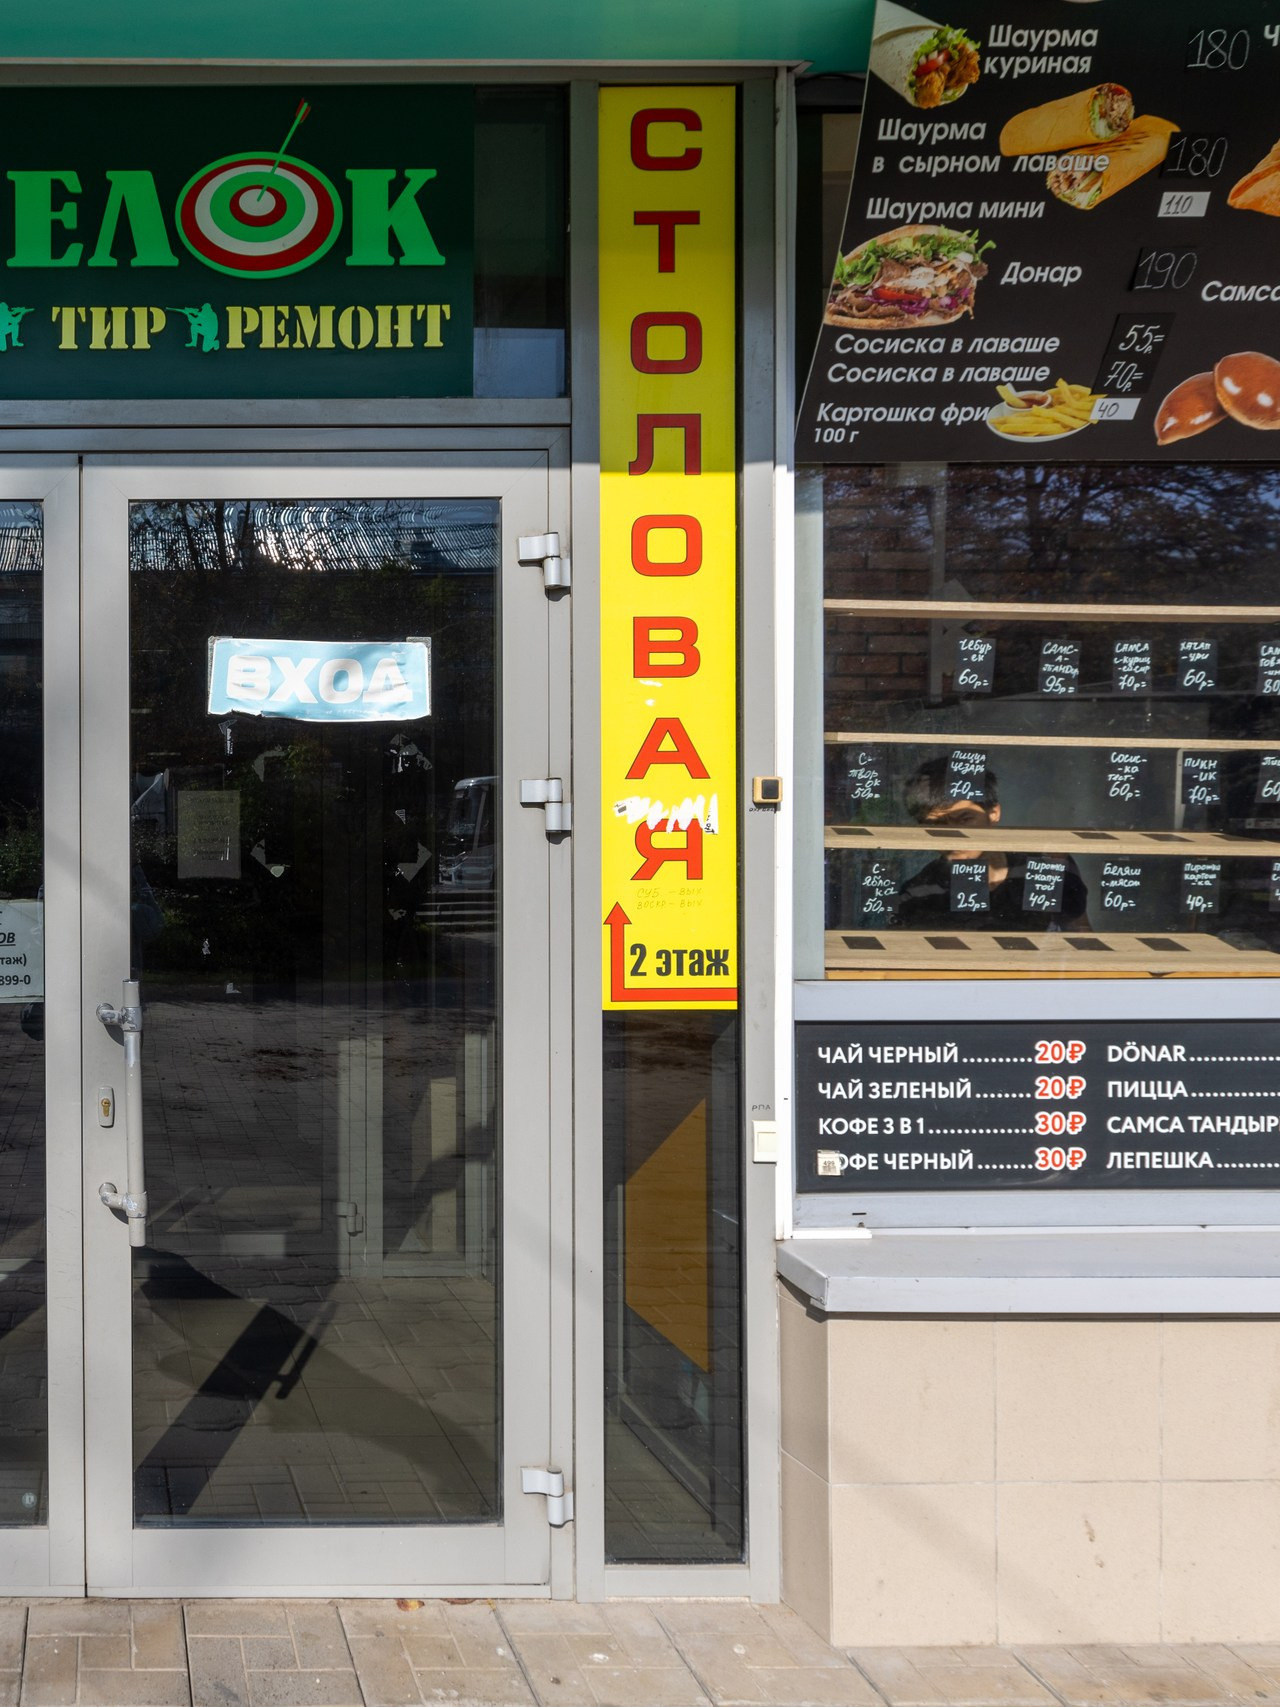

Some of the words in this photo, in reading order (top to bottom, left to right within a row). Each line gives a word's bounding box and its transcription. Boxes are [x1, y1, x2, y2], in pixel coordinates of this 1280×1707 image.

[988, 24, 1099, 51] Шаурма
[1186, 28, 1250, 71] 180
[984, 53, 1092, 79] куриная
[877, 118, 987, 145] Шаурма
[872, 156, 885, 173] в
[898, 155, 1001, 177] сырном
[1012, 154, 1111, 172] лаваше
[1166, 137, 1228, 178] 180
[866, 198, 973, 223] Шаурма
[978, 201, 1046, 219] мини
[1163, 195, 1194, 215] 110
[1000, 262, 1083, 287] Донар
[1134, 251, 1198, 290] 190
[52, 305, 167, 351] ТИР
[225, 304, 451, 350] РЕМОНТ
[834, 333, 945, 354] Сосиска
[950, 338, 963, 353] в
[967, 337, 1061, 354] лаваше
[827, 363, 938, 383] Сосиска
[942, 367, 955, 383] в
[959, 367, 1050, 383] лаваше
[817, 403, 936, 425] Картошка
[940, 403, 990, 425] фри
[814, 428, 846, 443] 100
[849, 431, 860, 443] г
[226, 655, 414, 704] ВХОД
[630, 943, 647, 977] 2
[656, 949, 730, 977] этаж
[817, 1043, 863, 1063] ЧАЙ
[868, 1043, 959, 1063] ЧЕРНЫЙ
[1107, 1041, 1186, 1062] DÖNAR
[817, 1078, 863, 1098] ЧАЙ
[868, 1078, 972, 1098] ЗЕЛЕНЫЙ
[1107, 1080, 1188, 1100] ПИЦЦА
[818, 1117, 879, 1135] КОФЕ
[883, 1117, 895, 1135] 3
[900, 1117, 912, 1135] В
[916, 1117, 925, 1135] 1
[1107, 1116, 1185, 1133] САМСА
[1188, 1116, 1280, 1135] ТАНДЫР
[883, 1149, 974, 1170] ЧЕРНЫЙ
[1106, 1151, 1215, 1169] ЛЕПЕШКА
